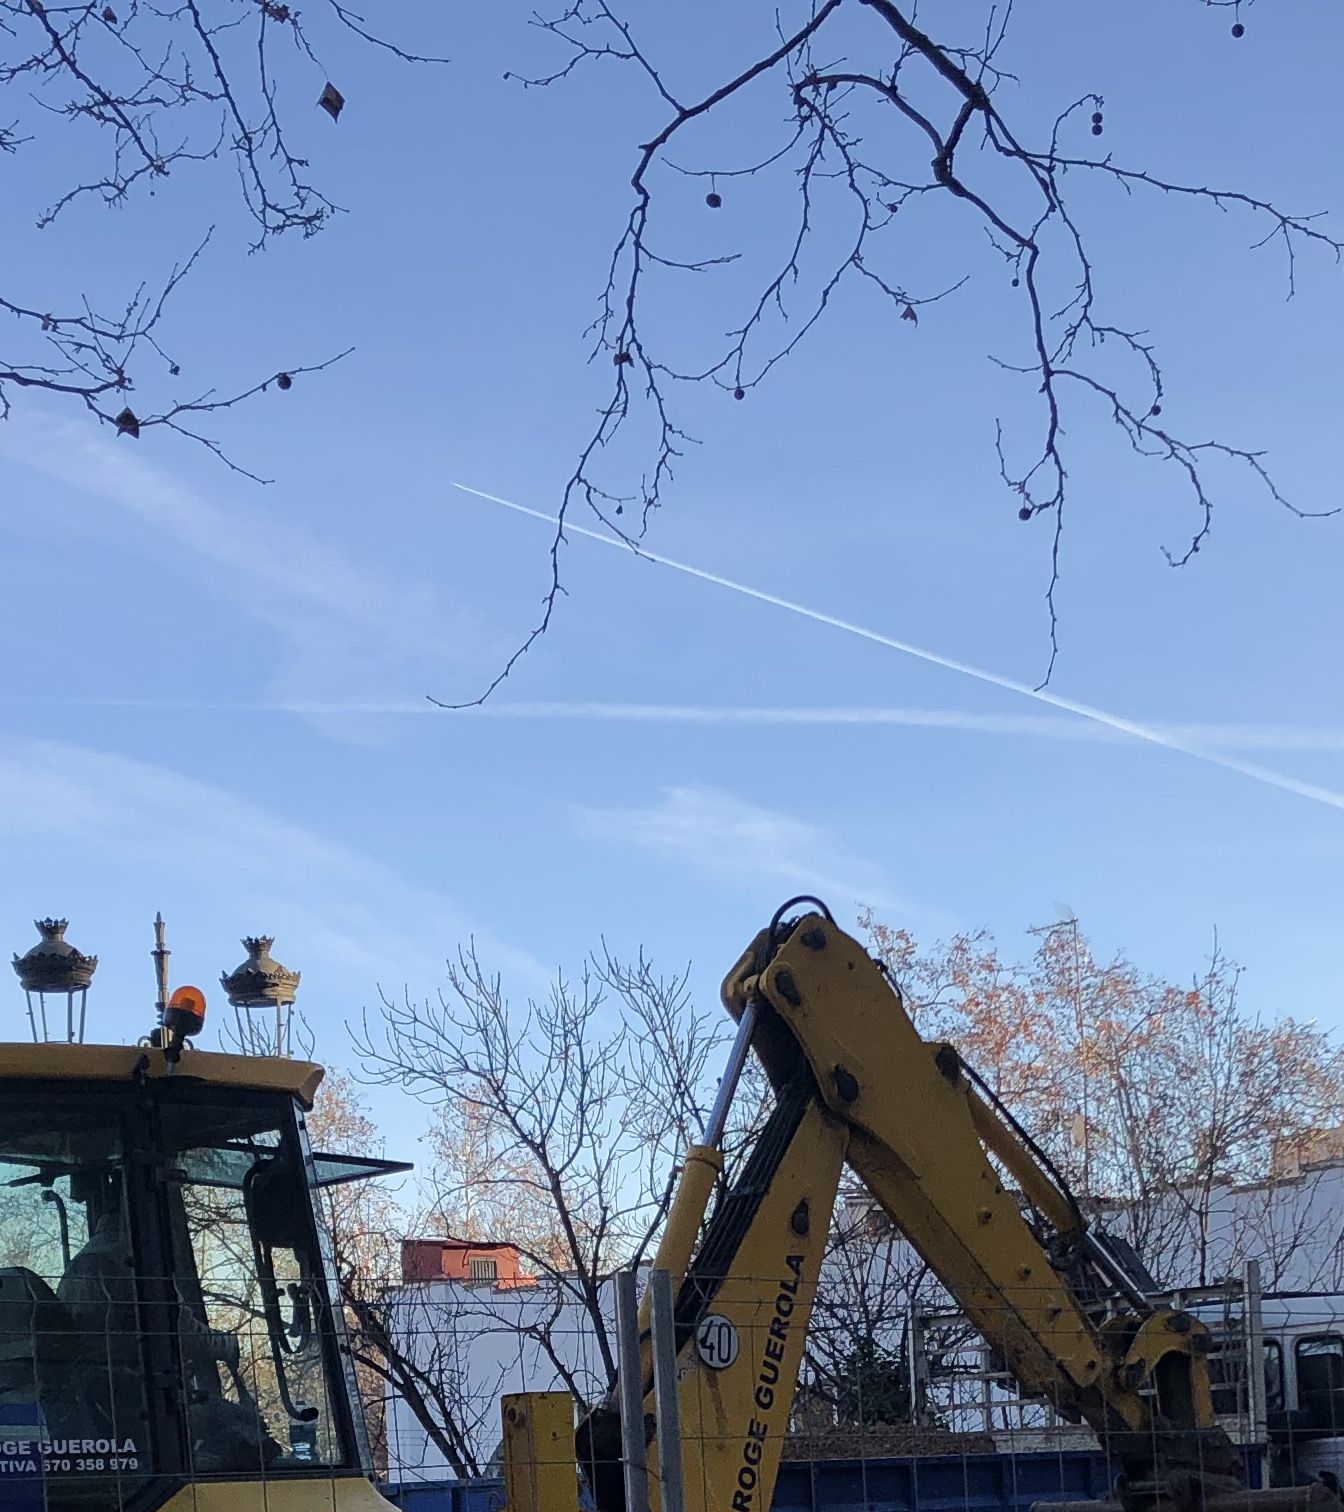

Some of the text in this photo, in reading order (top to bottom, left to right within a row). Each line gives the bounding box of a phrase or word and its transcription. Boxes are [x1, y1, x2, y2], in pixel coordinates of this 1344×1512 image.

[699, 1320, 732, 1364] 40
[755, 1255, 805, 1411] GUEROLA
[38, 1439, 137, 1454] GUEROLA
[76, 1459, 105, 1471] 358
[110, 1458, 139, 1470] 979
